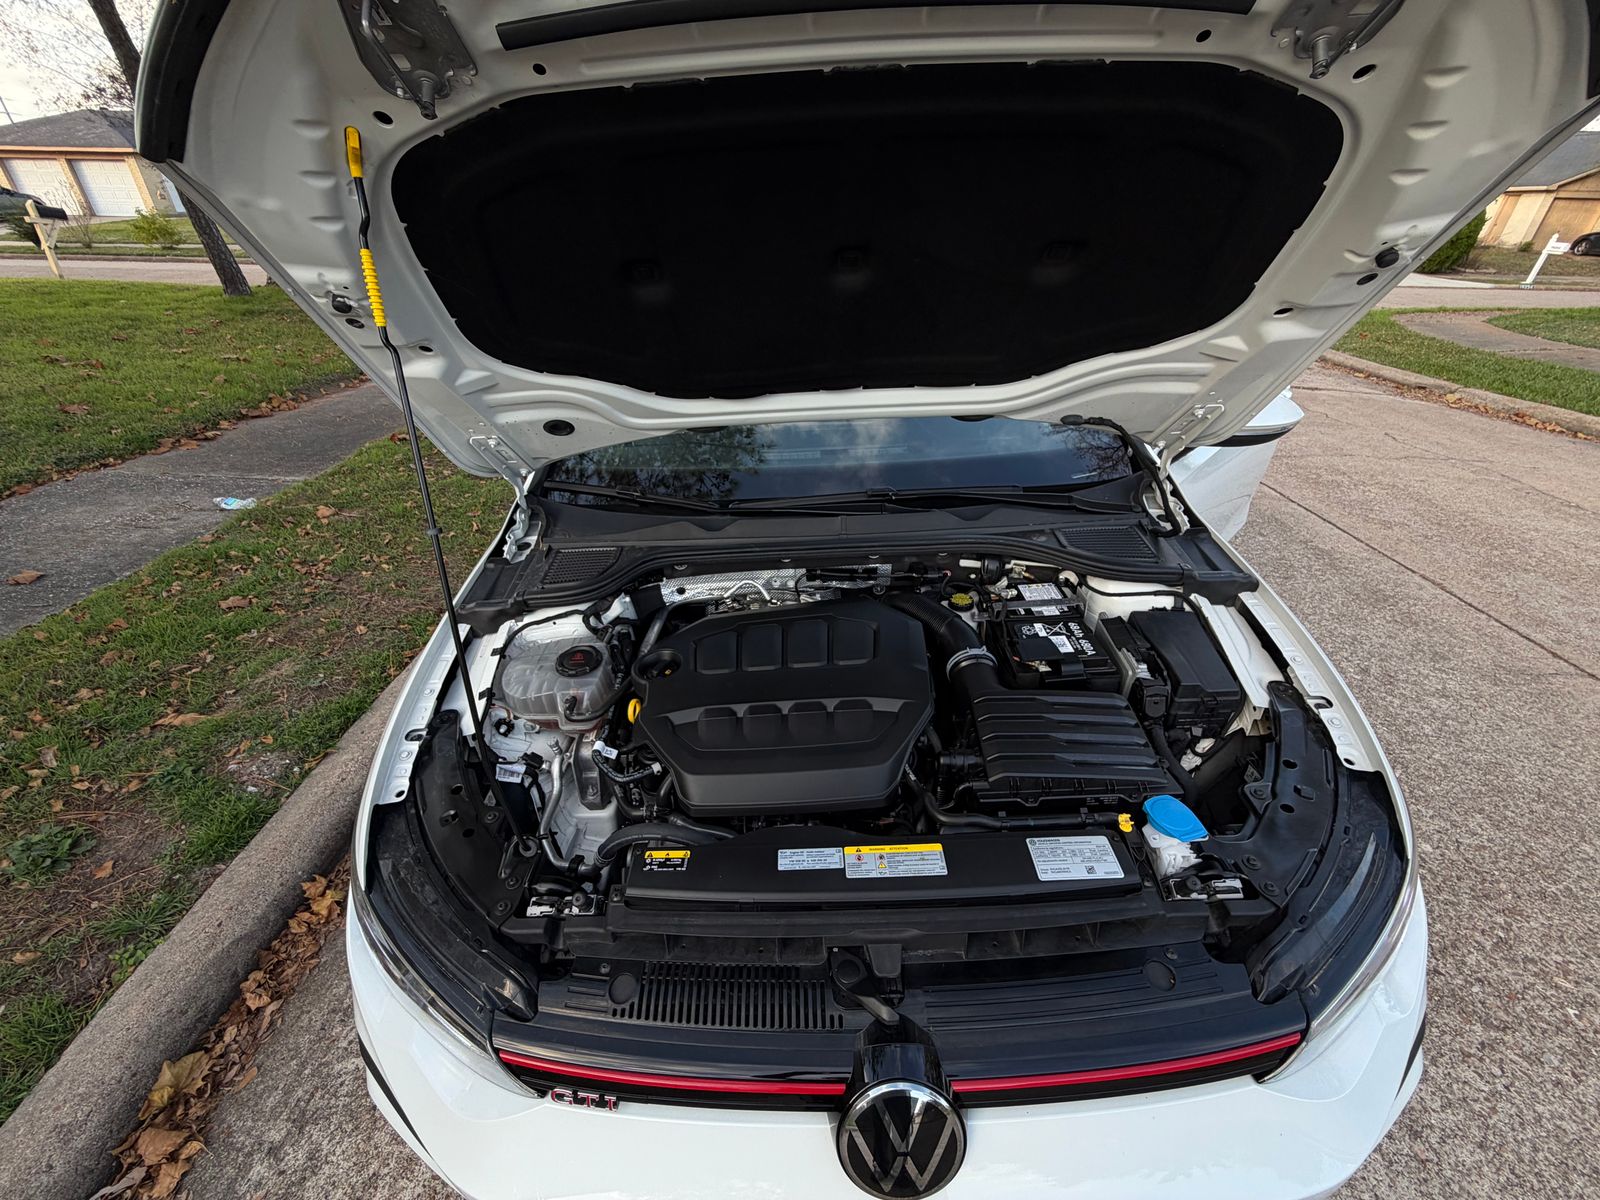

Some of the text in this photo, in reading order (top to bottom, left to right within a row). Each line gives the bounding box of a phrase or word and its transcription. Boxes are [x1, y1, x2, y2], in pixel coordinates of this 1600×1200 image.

[1068, 622, 1084, 638] 68Ah
[1078, 639, 1097, 656] 680A
[550, 1087, 617, 1112] GTI
[847, 1092, 957, 1193] VW
